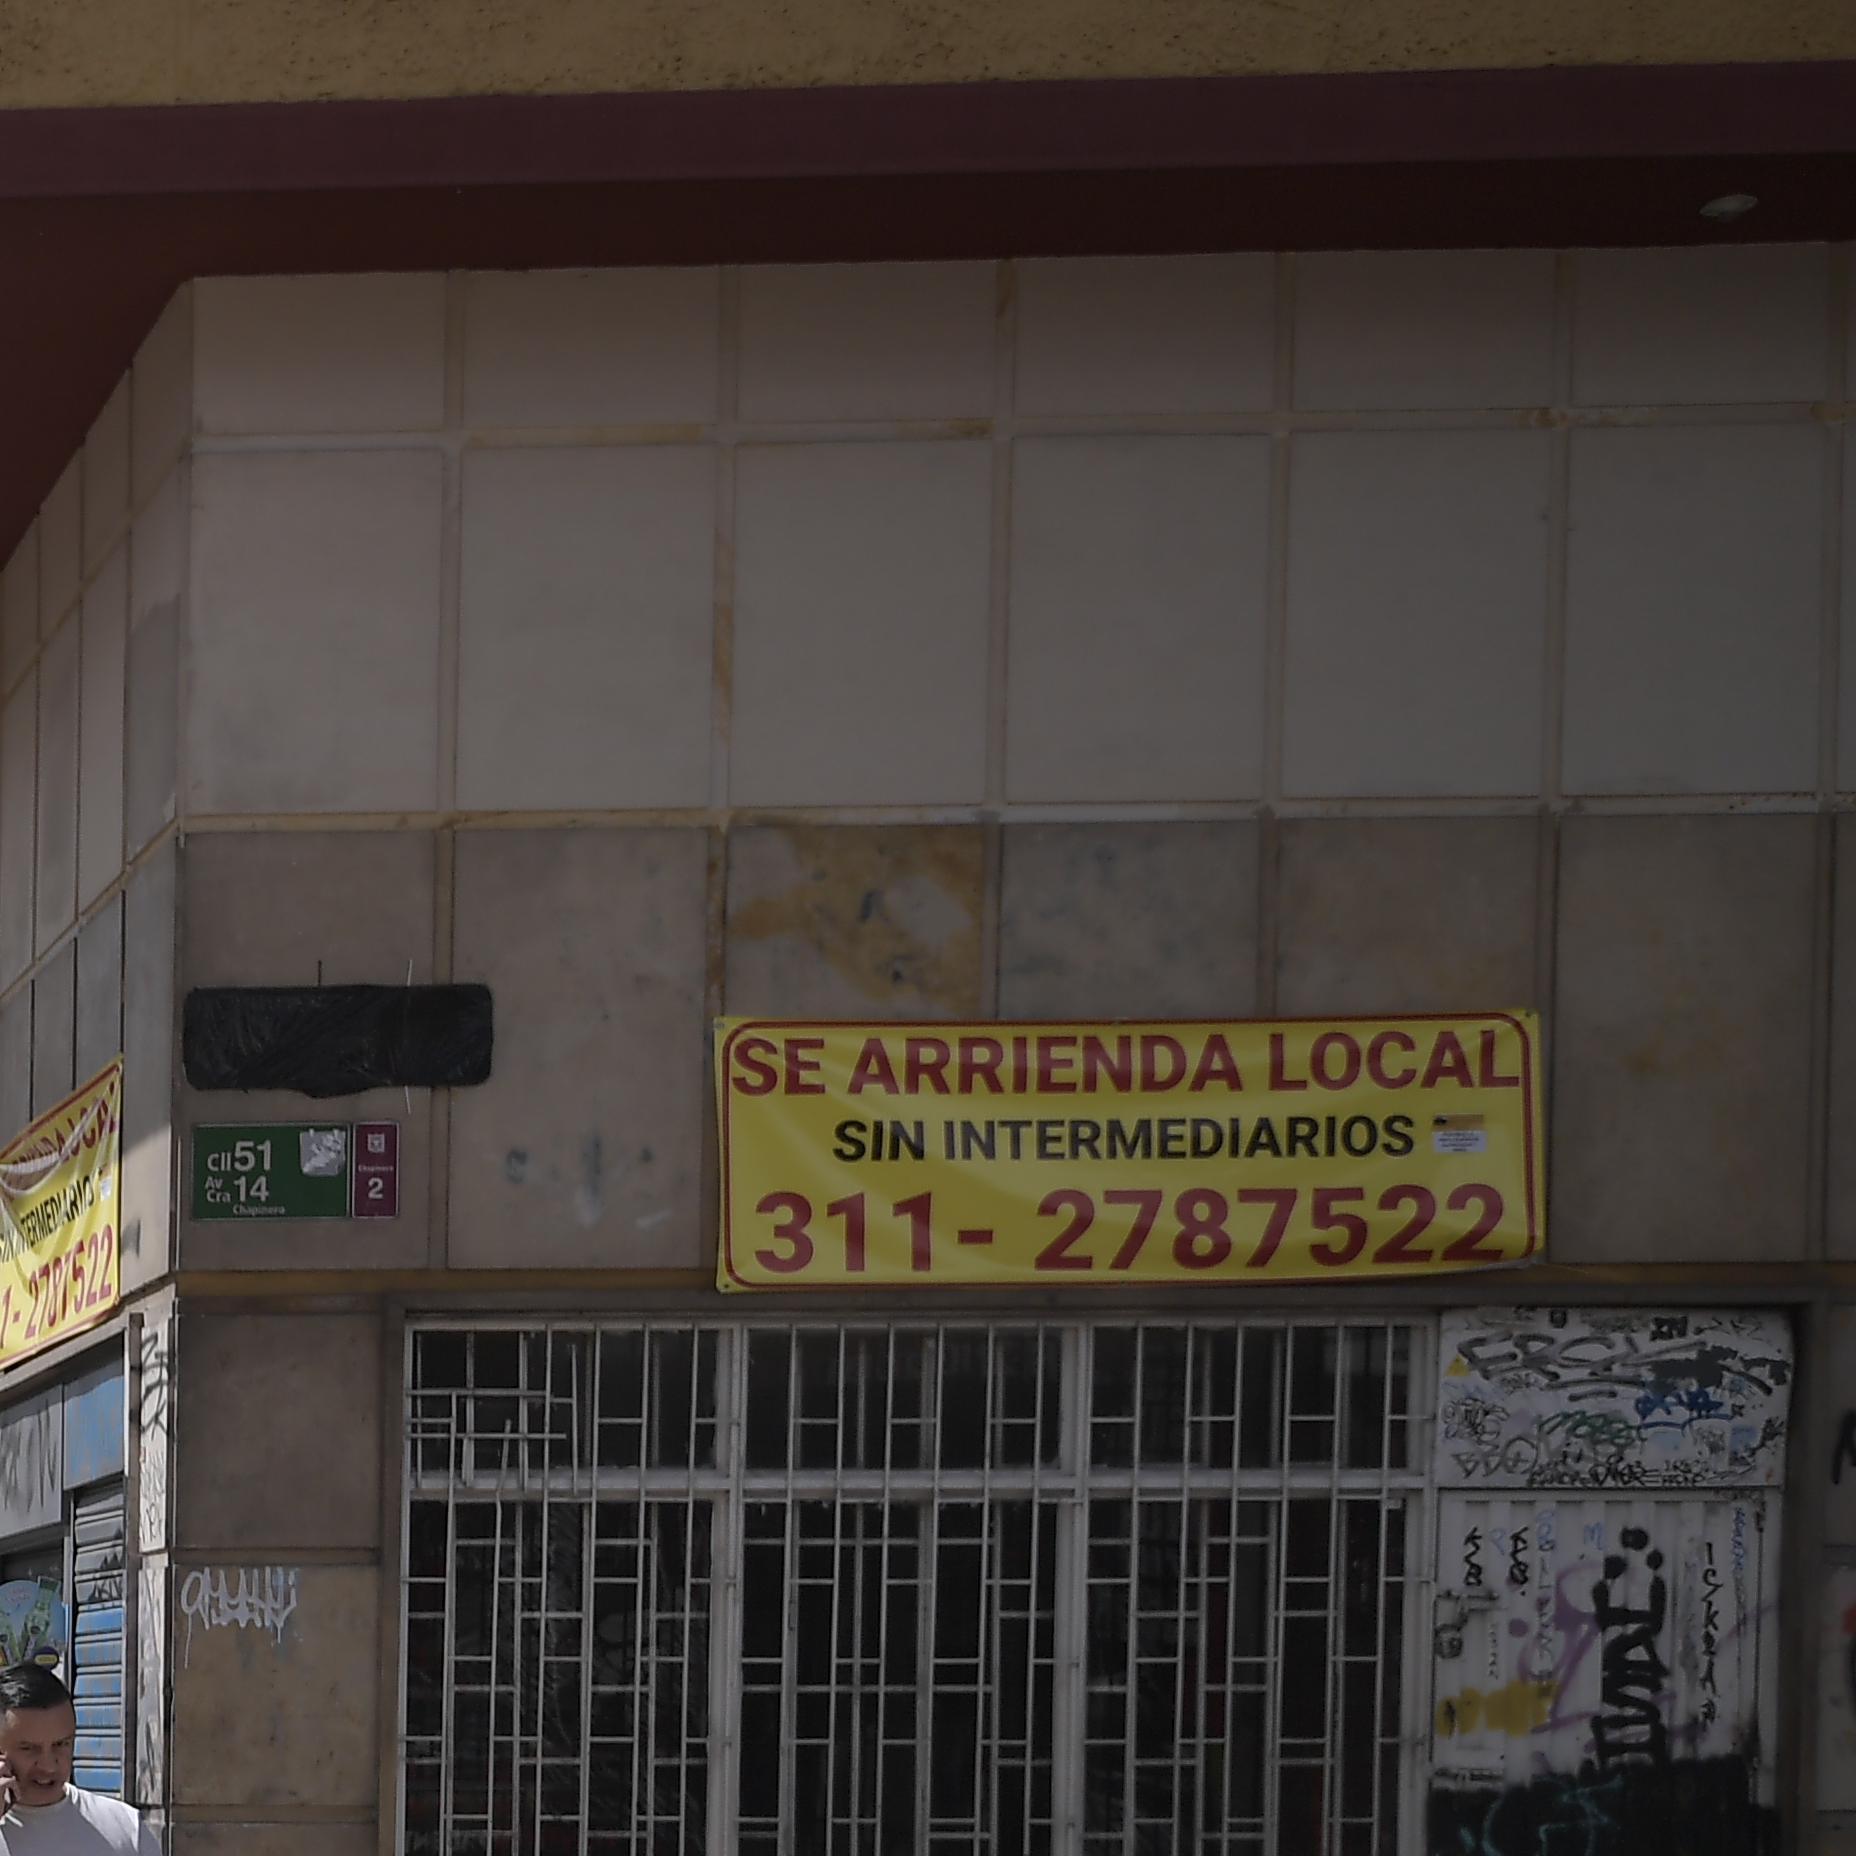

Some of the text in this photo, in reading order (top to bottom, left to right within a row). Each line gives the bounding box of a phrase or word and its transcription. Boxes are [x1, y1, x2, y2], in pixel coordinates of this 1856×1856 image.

[731, 1029, 1520, 1096] SE ARRIENDA LOCAL
[832, 1118, 926, 1162] SIN
[943, 1114, 1414, 1160] INTERMEDIARIOS
[234, 1139, 272, 1172] 51
[205, 1175, 223, 1189] Av
[206, 1175, 269, 1202] Cra 14
[367, 1177, 383, 1199] 2
[1034, 1182, 1506, 1272] 2787522
